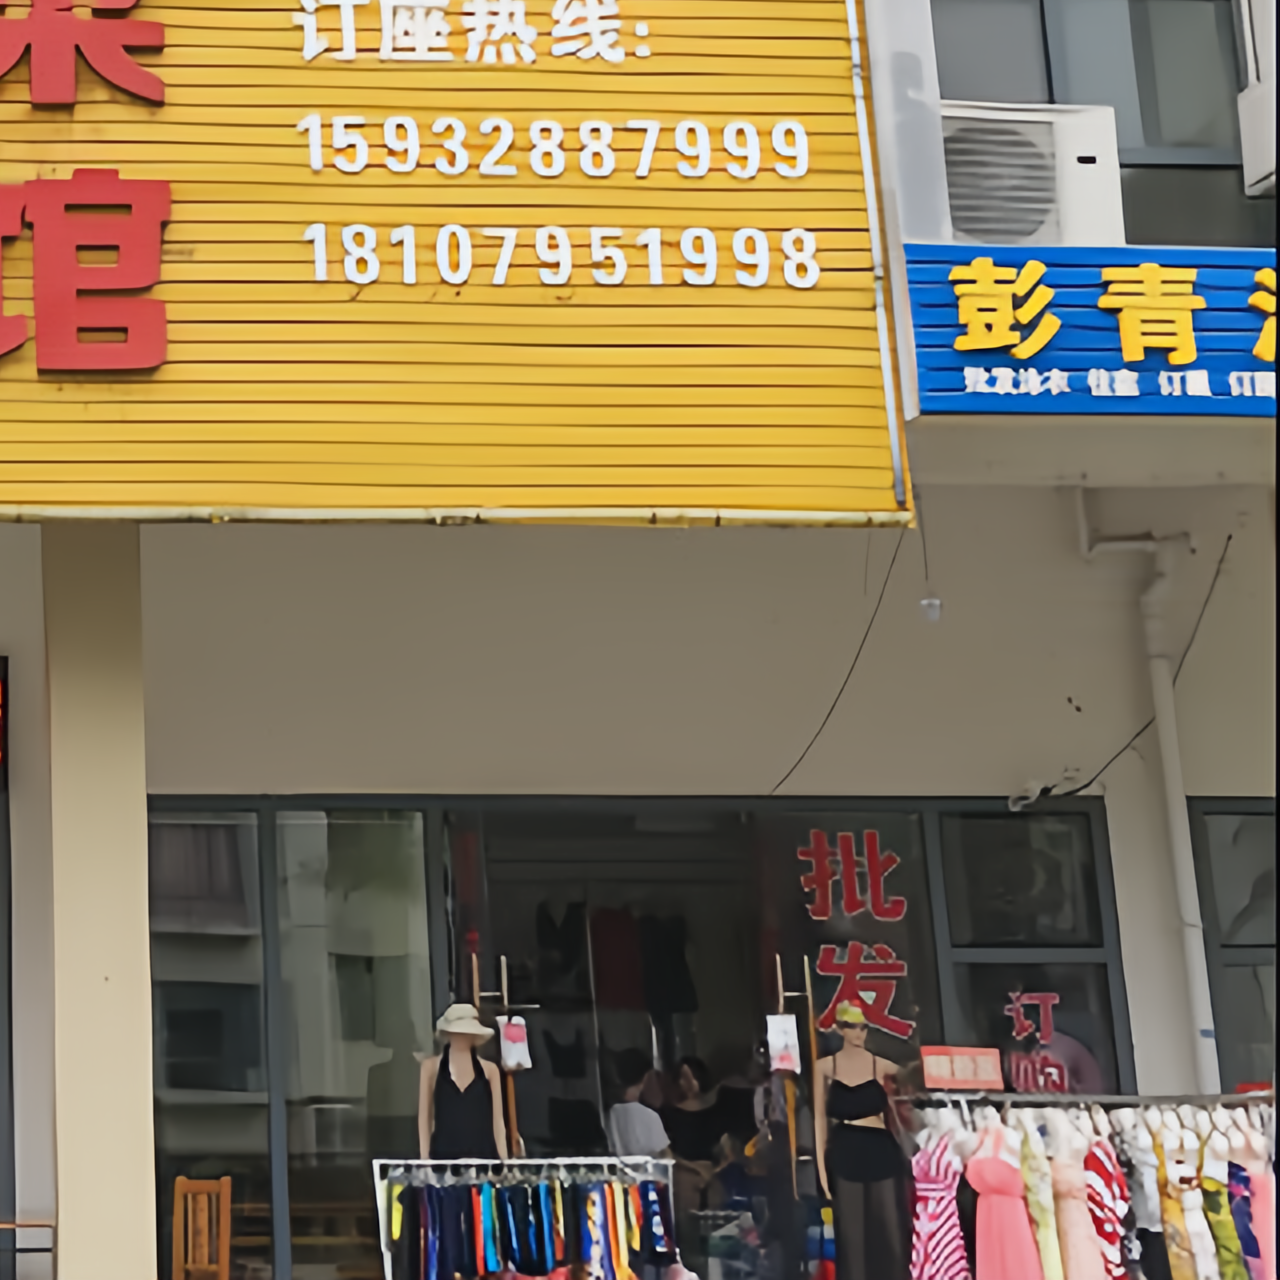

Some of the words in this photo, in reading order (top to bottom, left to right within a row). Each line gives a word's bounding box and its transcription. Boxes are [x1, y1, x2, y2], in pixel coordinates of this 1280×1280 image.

[296, 113, 810, 179] 15932887999
[303, 223, 821, 288] 18107951998
[796, 828, 917, 1040] 批发
